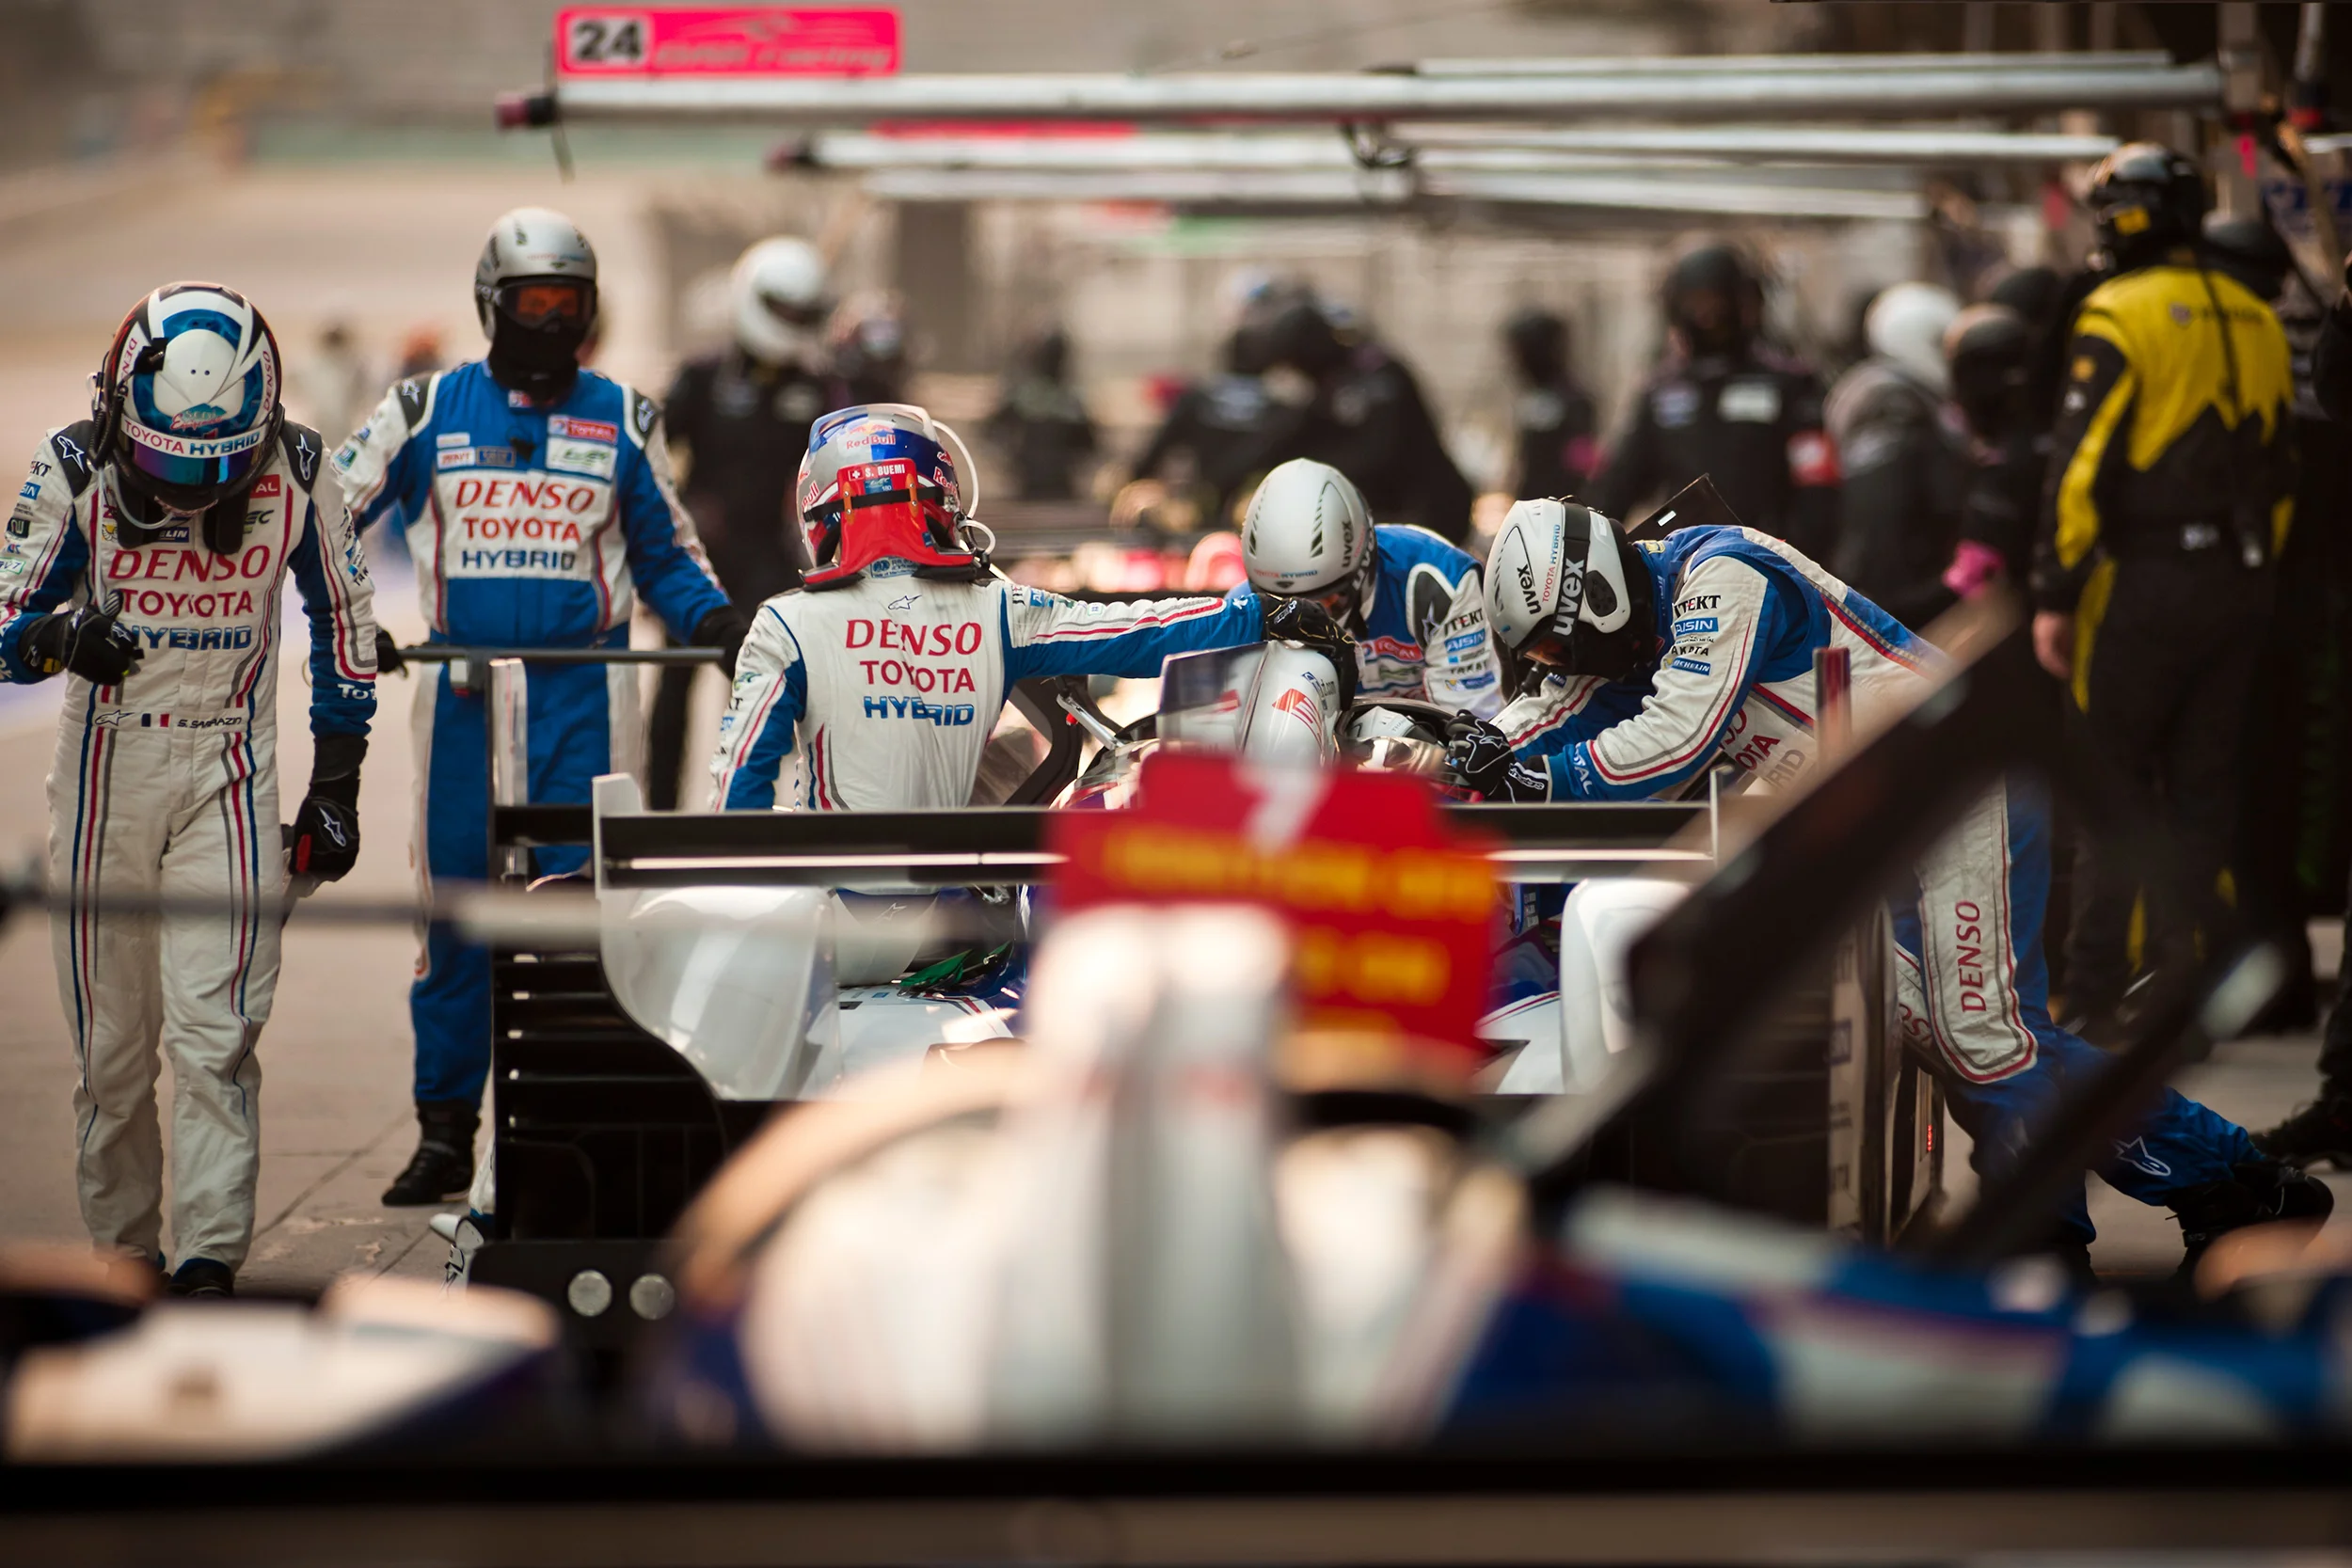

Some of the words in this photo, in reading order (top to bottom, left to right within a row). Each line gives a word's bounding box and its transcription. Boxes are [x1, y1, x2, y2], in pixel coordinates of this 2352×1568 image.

[575, 20, 642, 63] 24
[262, 350, 273, 412] DENSO
[123, 419, 185, 455] TOYOTA
[189, 431, 261, 456] HYBRID
[846, 436, 870, 450] Red
[870, 434, 897, 446] Bull
[865, 467, 875, 478] S.
[877, 464, 905, 476] BUEMI
[455, 479, 596, 515] DENSO
[462, 516, 582, 544] TOYOTA
[1341, 520, 1354, 568] uvex
[107, 545, 271, 583] DENSO
[462, 549, 576, 572] HYBRID
[1542, 566, 1556, 603] TOYOTA
[1549, 524, 1562, 564] HYBRID
[119, 588, 254, 619] TOYOTA
[1517, 563, 1542, 615] uvex
[1552, 558, 1585, 637] uvex
[846, 618, 982, 658] DENSO
[1446, 634, 1485, 651] AISIN
[859, 658, 976, 694] TOYOTA
[863, 694, 975, 727] HYBRID
[1955, 900, 1987, 1013] DENSO
